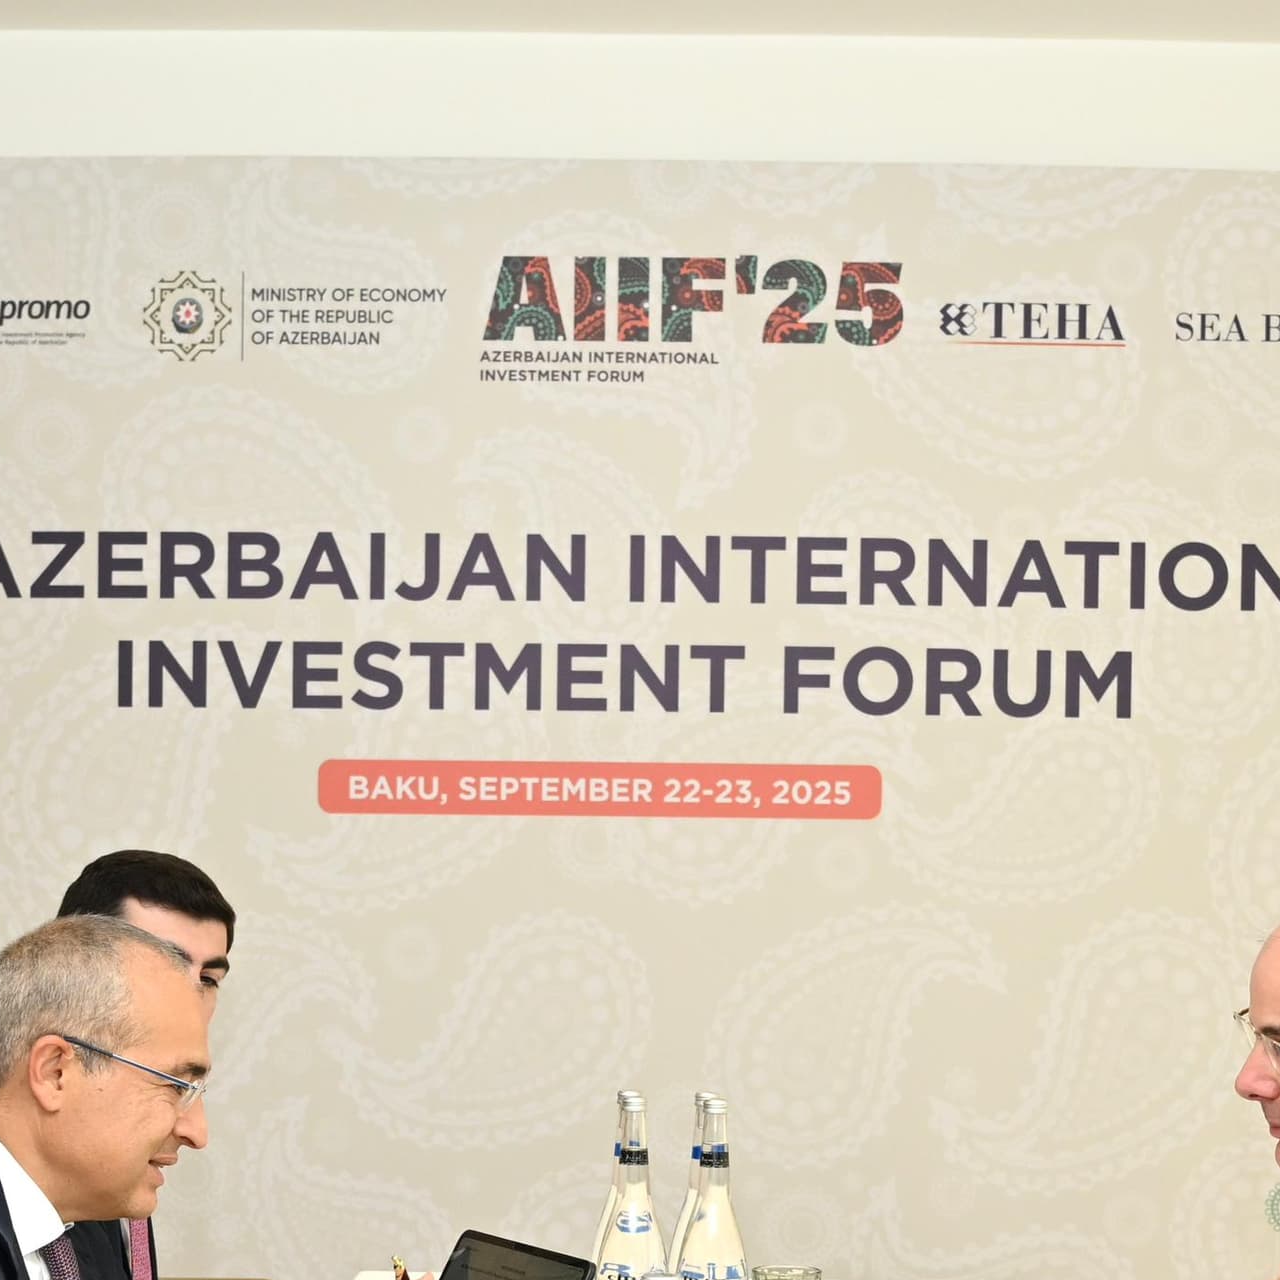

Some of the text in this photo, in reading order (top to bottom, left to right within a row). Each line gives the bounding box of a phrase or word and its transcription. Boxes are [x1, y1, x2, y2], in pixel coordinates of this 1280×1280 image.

[250, 287, 447, 303] MINISTRY OF ECONOMY
[483, 255, 903, 346] AIIF'25
[251, 309, 394, 325] OF THE REPUBLIC
[982, 301, 1125, 341] TEHA
[1175, 312, 1249, 342] SEA
[251, 330, 380, 346] OF AZERBAIJAN
[479, 349, 720, 366] AZERBAIJAN INTERNATIONAL
[479, 368, 645, 383] INVESTMENT FORUM
[117, 639, 1133, 721] INVESTMENT FORUM
[349, 775, 851, 809] BAKU, SEPTEMBER 22-23, 2025
